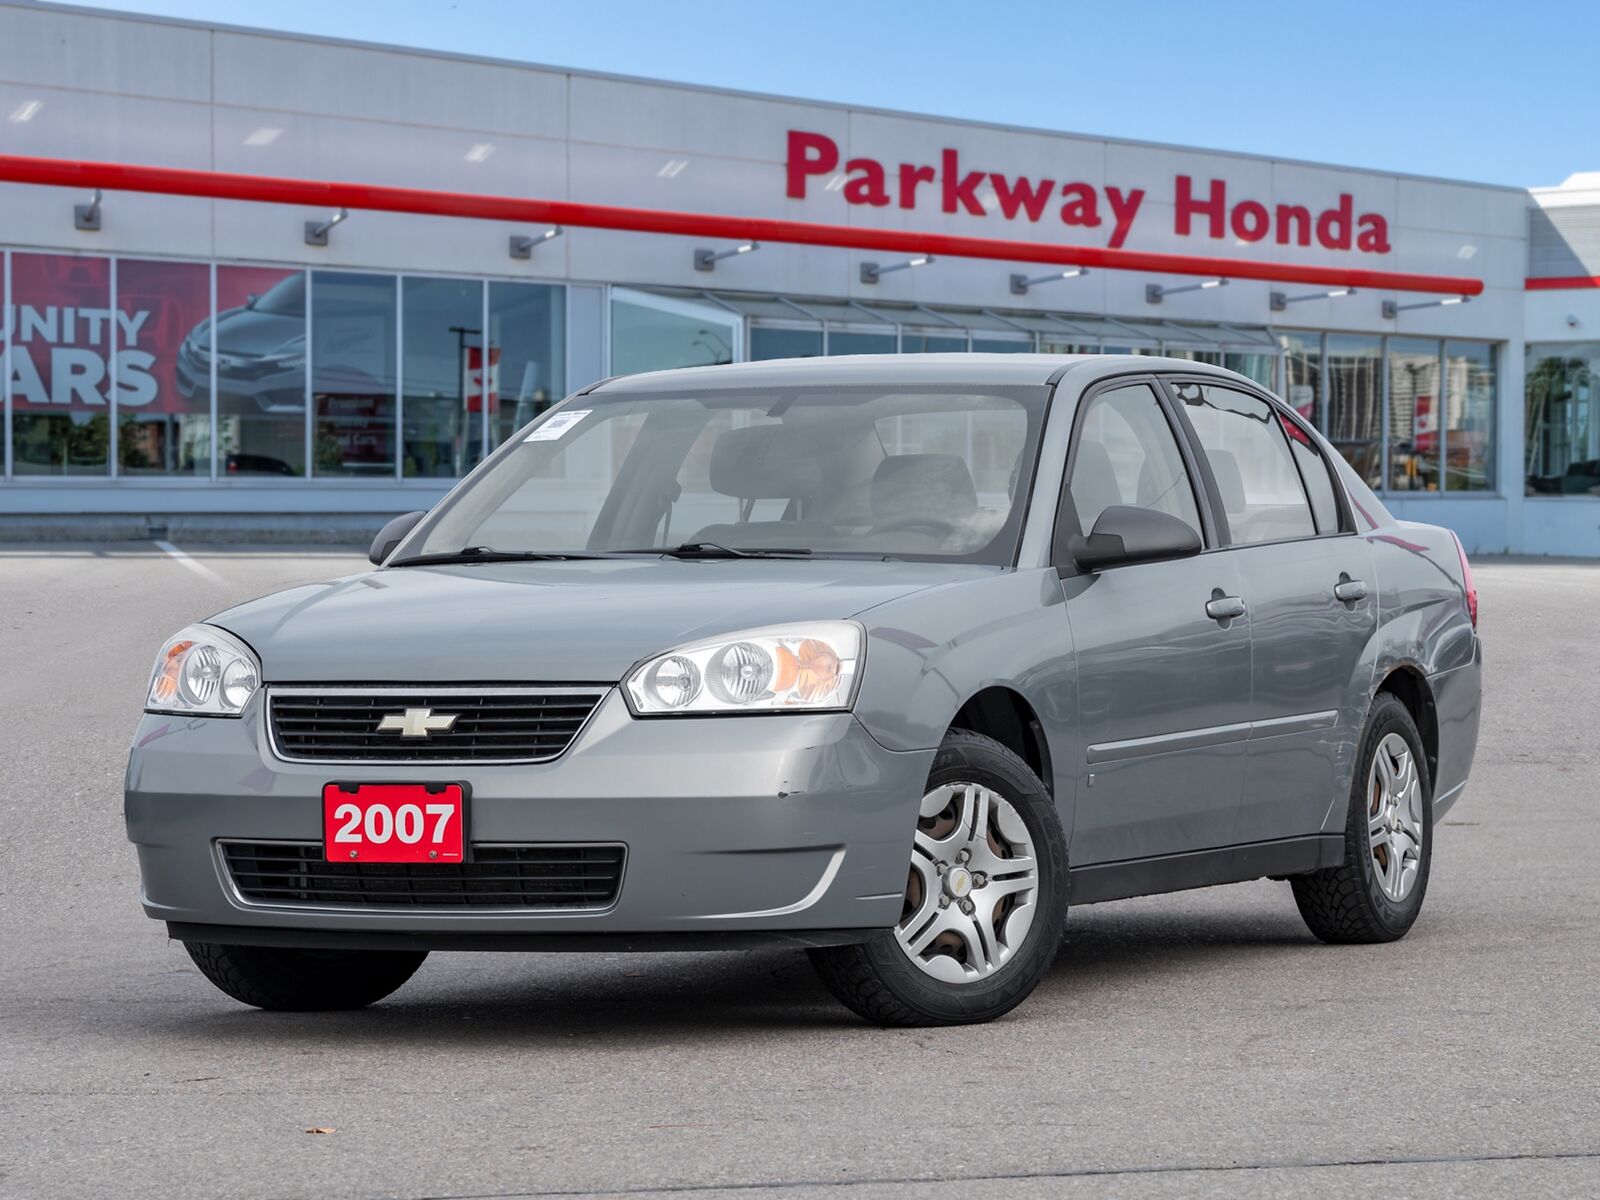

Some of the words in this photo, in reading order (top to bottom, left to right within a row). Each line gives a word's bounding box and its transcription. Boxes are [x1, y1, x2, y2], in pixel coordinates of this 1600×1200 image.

[786, 130, 1145, 248] Parkway
[1175, 175, 1391, 253] Honda
[334, 803, 455, 844] 2007
